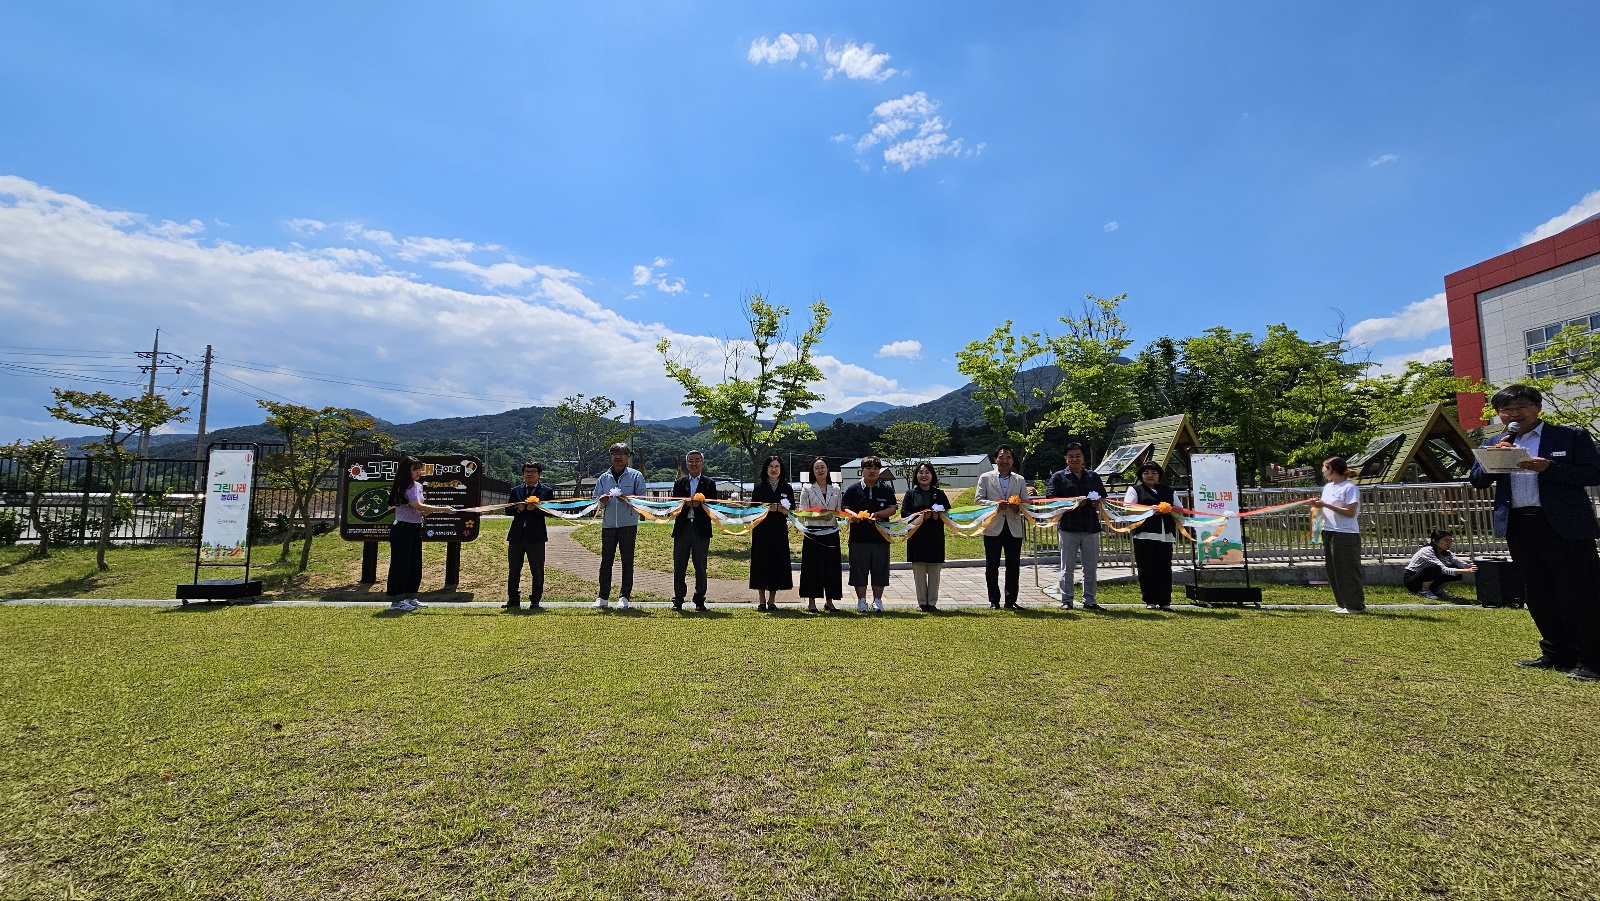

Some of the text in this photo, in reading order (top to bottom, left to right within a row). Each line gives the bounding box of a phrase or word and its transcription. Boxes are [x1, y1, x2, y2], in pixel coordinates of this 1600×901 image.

[435, 464, 461, 475] 놀이터
[213, 483, 247, 493] 그린나래
[220, 493, 239, 501] 놀이터
[1199, 491, 1233, 501] 그린나래
